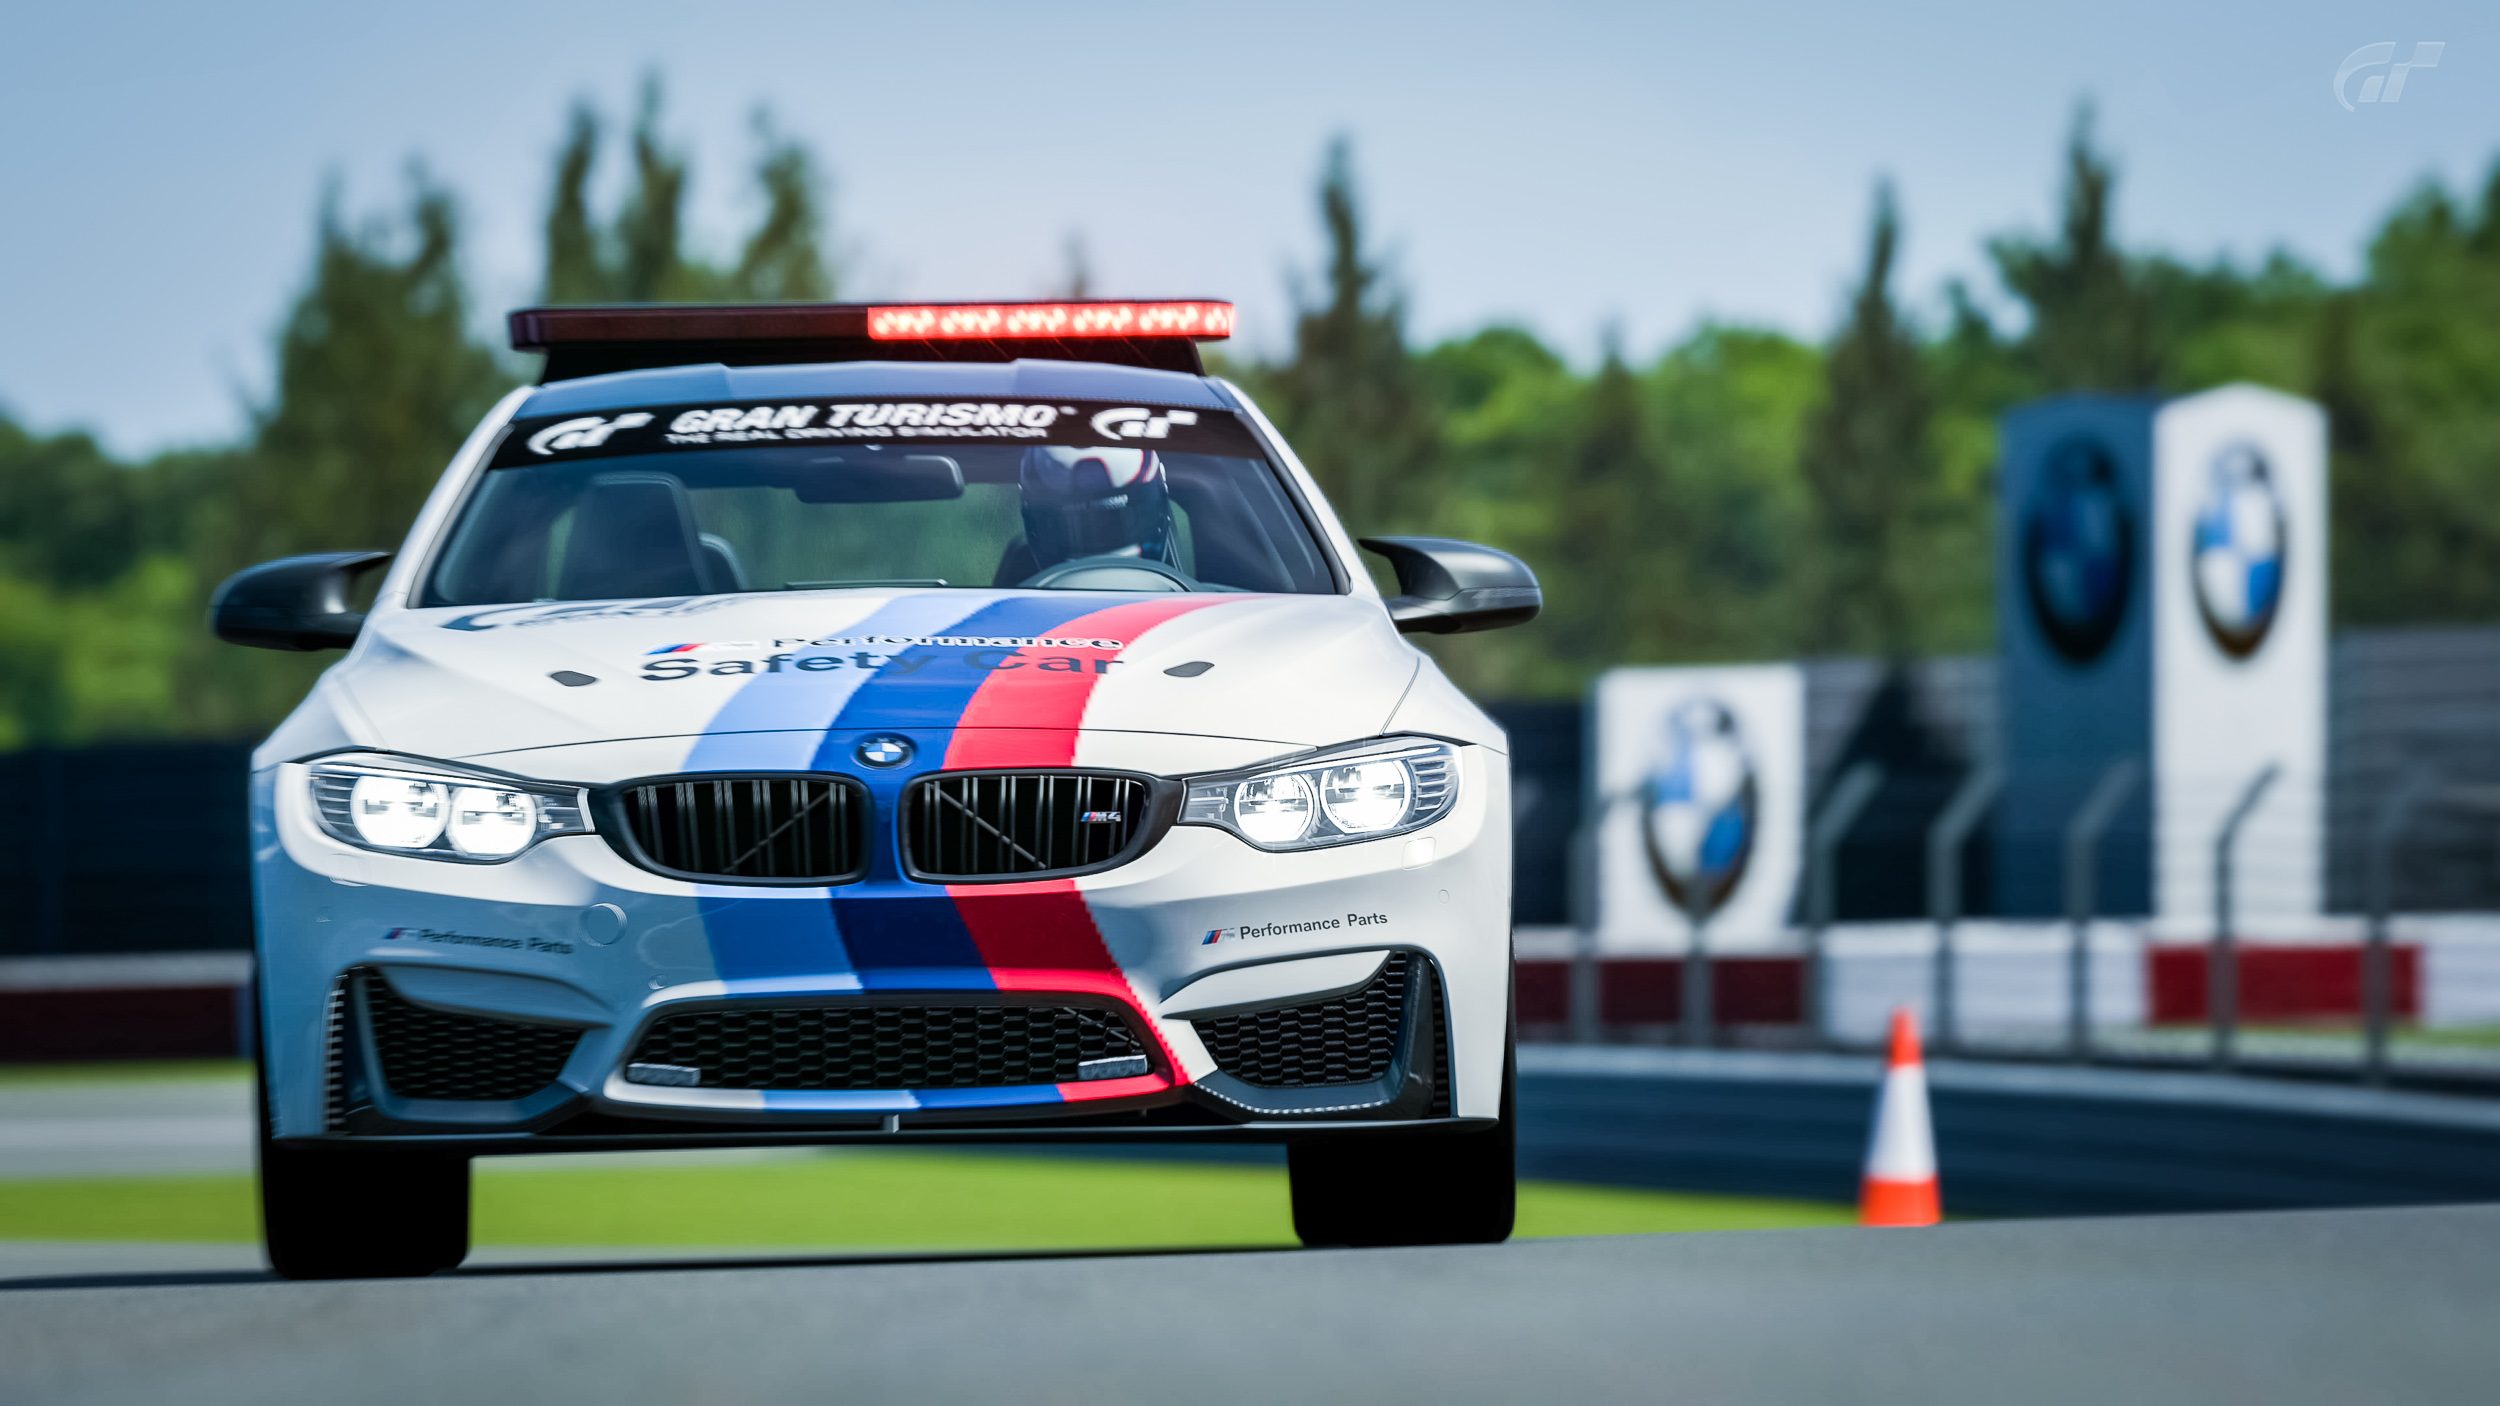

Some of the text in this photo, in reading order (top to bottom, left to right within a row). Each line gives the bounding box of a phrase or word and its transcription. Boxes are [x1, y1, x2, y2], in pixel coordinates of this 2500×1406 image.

[669, 403, 1059, 434] GRAN TURISMO
[769, 635, 1124, 651] Performance
[639, 650, 1125, 681] Safety Car
[1240, 912, 1389, 940] Performance Parts
